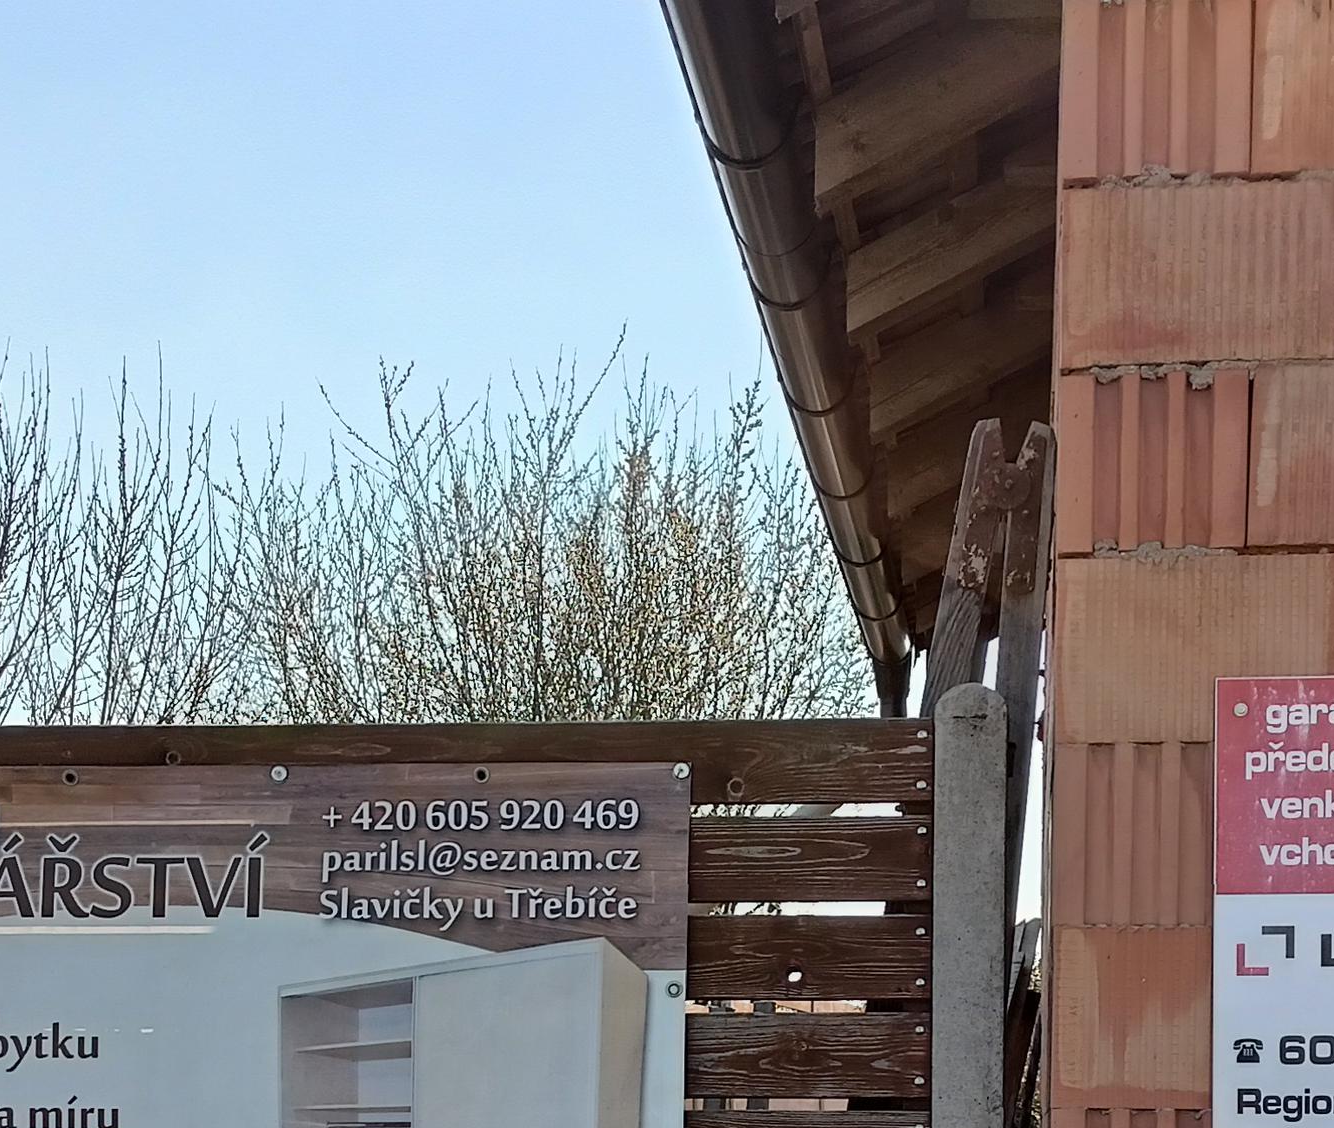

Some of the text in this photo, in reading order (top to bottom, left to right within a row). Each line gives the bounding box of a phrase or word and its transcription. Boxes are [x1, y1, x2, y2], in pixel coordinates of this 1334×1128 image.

[425, 800, 489, 830] 605
[499, 800, 564, 830] 920
[573, 800, 640, 829] 469
[321, 839, 640, 882] parilsl@seznam.cz
[319, 886, 638, 931] Slavičky u Třebíče
